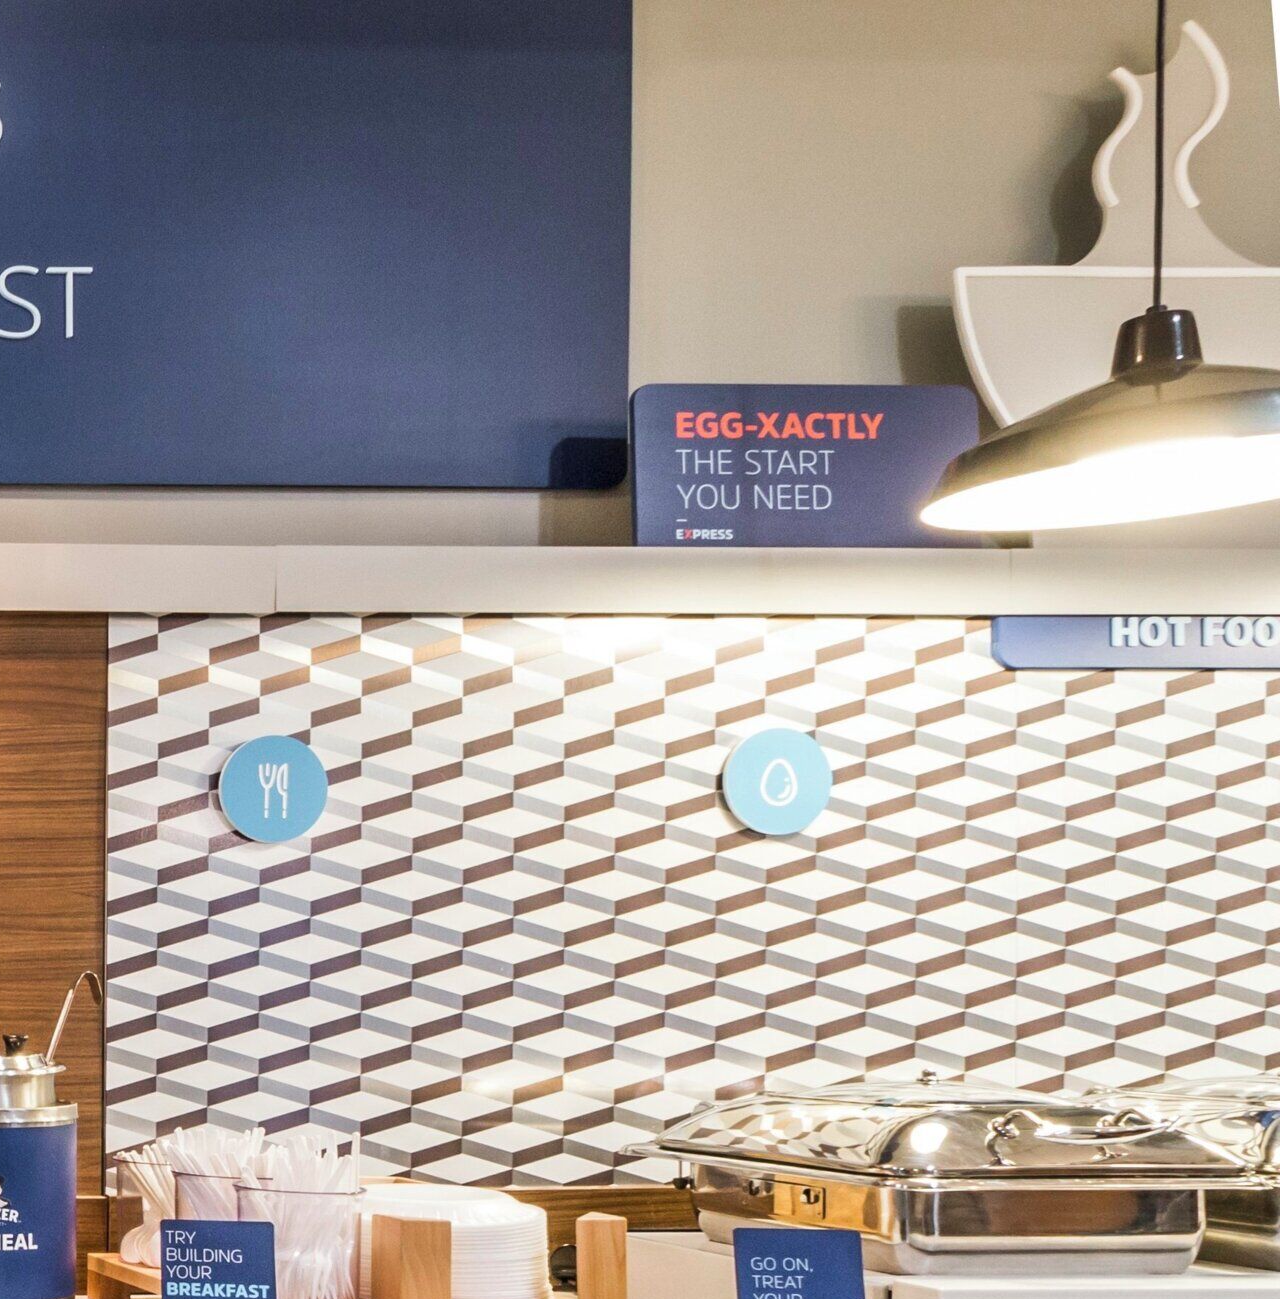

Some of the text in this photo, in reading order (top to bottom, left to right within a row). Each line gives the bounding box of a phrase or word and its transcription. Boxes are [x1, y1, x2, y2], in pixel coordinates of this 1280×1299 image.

[675, 411, 885, 440] EGG-XACTLY
[675, 449, 835, 475] THE START
[676, 484, 833, 510] YOU NEED
[675, 529, 734, 541] EXPRESS
[1110, 616, 1280, 647] HOT FOO
[165, 1230, 196, 1244] TRY
[166, 1247, 243, 1264] BUILDING
[750, 1256, 776, 1271] GO
[166, 1265, 212, 1280] YOUR
[752, 1274, 804, 1289] TREAT
[166, 1282, 270, 1299] BREAKFAST
